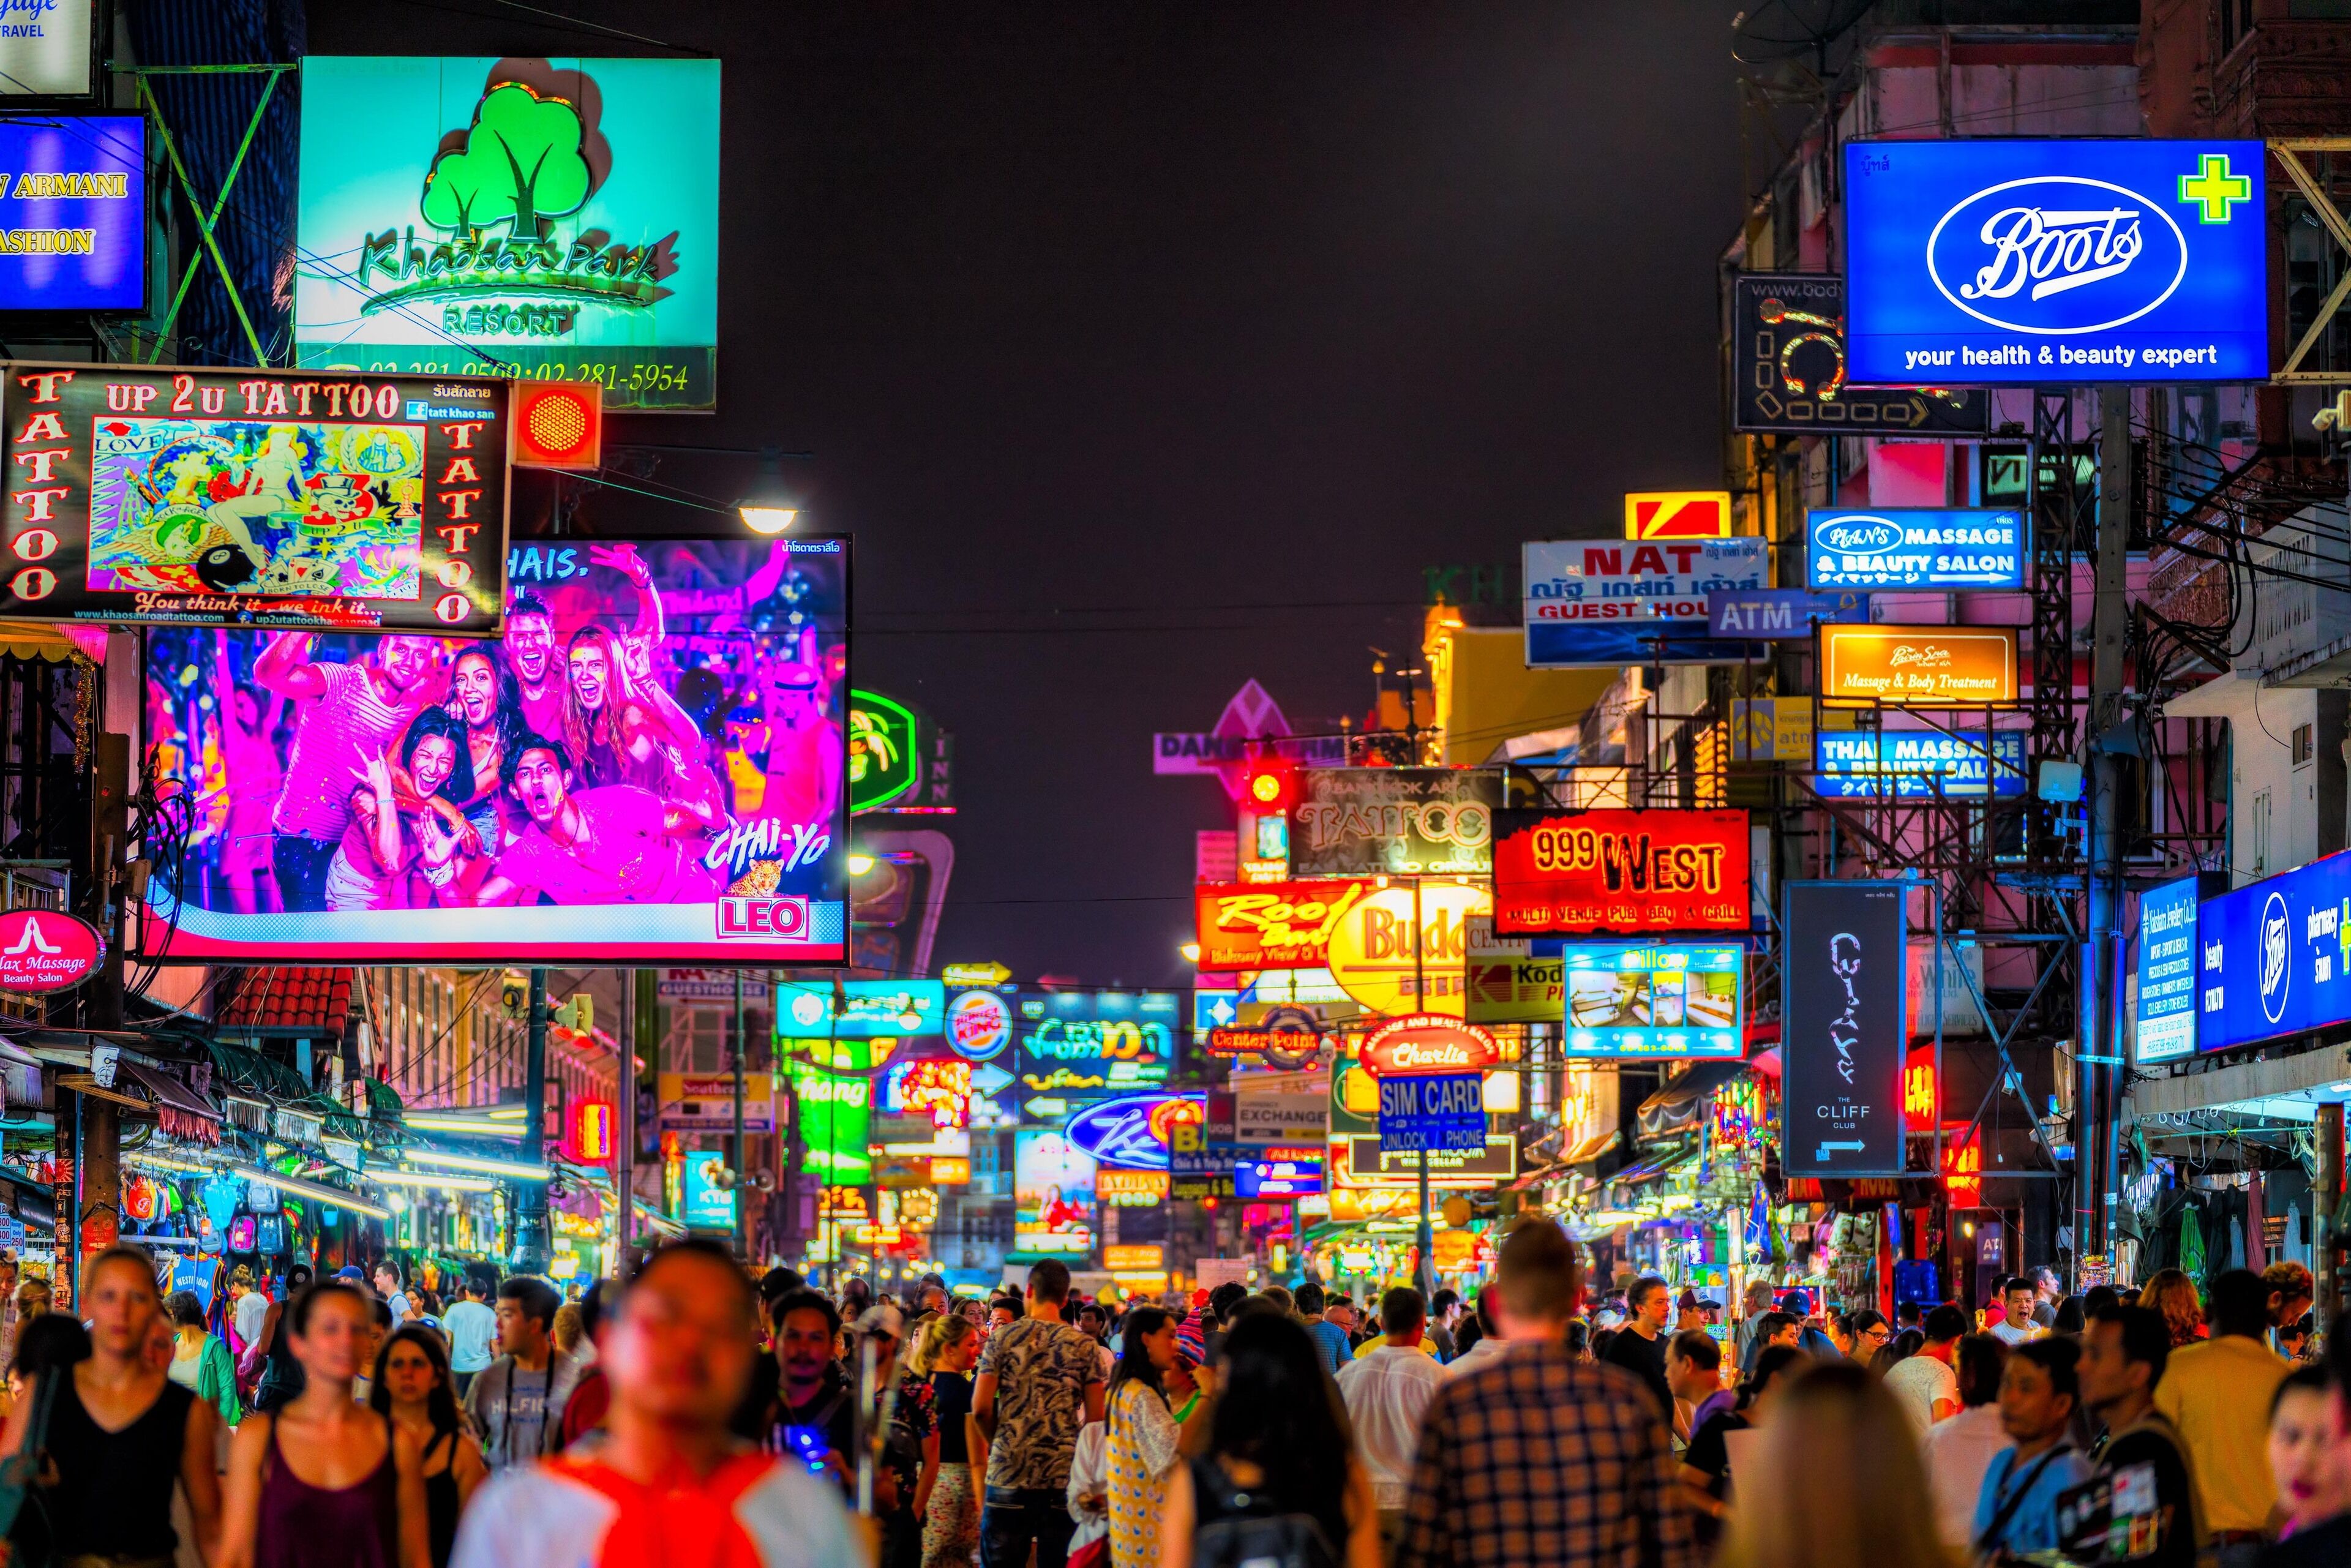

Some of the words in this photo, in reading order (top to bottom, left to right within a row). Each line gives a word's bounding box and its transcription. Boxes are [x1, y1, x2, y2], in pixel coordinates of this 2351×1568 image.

[0, 25, 44, 37] RAVEL
[15, 174, 126, 197] ARMANI
[361, 241, 552, 285] Khaosan
[563, 243, 659, 284] Park
[1960, 206, 2143, 301] Boots
[443, 310, 567, 335] RESORT
[1905, 347, 1956, 370] your
[1961, 343, 2031, 366] health
[2038, 345, 2054, 366] &
[2059, 343, 2137, 370] beauty
[2143, 345, 2218, 370] expert
[106, 383, 159, 413] UP
[239, 380, 402, 419] TATTOO
[429, 408, 449, 419] tatt
[449, 408, 474, 419] khao
[476, 409, 495, 419] san
[94, 434, 163, 453] LOVE
[7, 370, 77, 602] TATTOO
[433, 422, 484, 625] TATTOO
[1904, 528, 2014, 545] MASSAGE
[1584, 545, 1703, 576] NAT
[1816, 555, 1836, 572] &
[1842, 555, 1931, 572] BEAUTY
[1936, 555, 2014, 572] SALON
[135, 592, 180, 614] You
[186, 593, 239, 612] think
[244, 598, 262, 612] it
[311, 599, 344, 614] ink
[1538, 603, 1638, 620] GUEST
[1719, 602, 1792, 631] ATM
[1843, 672, 1890, 691] Massage
[1893, 673, 1905, 688] &
[1908, 673, 1936, 692] Body
[1939, 673, 1997, 690] Treatment
[1895, 739, 2019, 759] MASSAGE
[1850, 760, 1937, 780] BEAUTY
[1944, 760, 2020, 779] SALON
[1295, 800, 1491, 850] TATTOO
[1534, 829, 1597, 870] 999
[722, 898, 806, 936] LEO
[1508, 906, 1551, 925] MULTI
[1556, 906, 1603, 923] VENUE
[1607, 905, 1639, 923] PUB
[1702, 904, 1742, 923] GRILL
[2205, 939, 2224, 974] beauty
[2308, 906, 2338, 946] pharmacy
[26, 955, 86, 973] Massage
[1624, 949, 1690, 969] Pillow
[2263, 915, 2285, 996] Boots
[4, 974, 35, 985] Beauty
[38, 973, 62, 982] Salon
[957, 1017, 1002, 1042] KING
[1408, 1017, 1429, 1027] AND
[1392, 1043, 1469, 1068] Charlie
[1381, 1082, 1419, 1117] SIM
[1425, 1079, 1482, 1115] CARD
[1240, 1109, 1327, 1123] EXCHANGE
[1817, 1105, 1870, 1119] CLIFF
[1382, 1131, 1427, 1150] UNLOCK
[1445, 1128, 1484, 1147] PHONE
[1401, 1157, 1420, 1168] WIN
[1427, 1157, 1465, 1168] CELLAR
[11, 1237, 23, 1247] 250
[1983, 1237, 2002, 1251] AT
